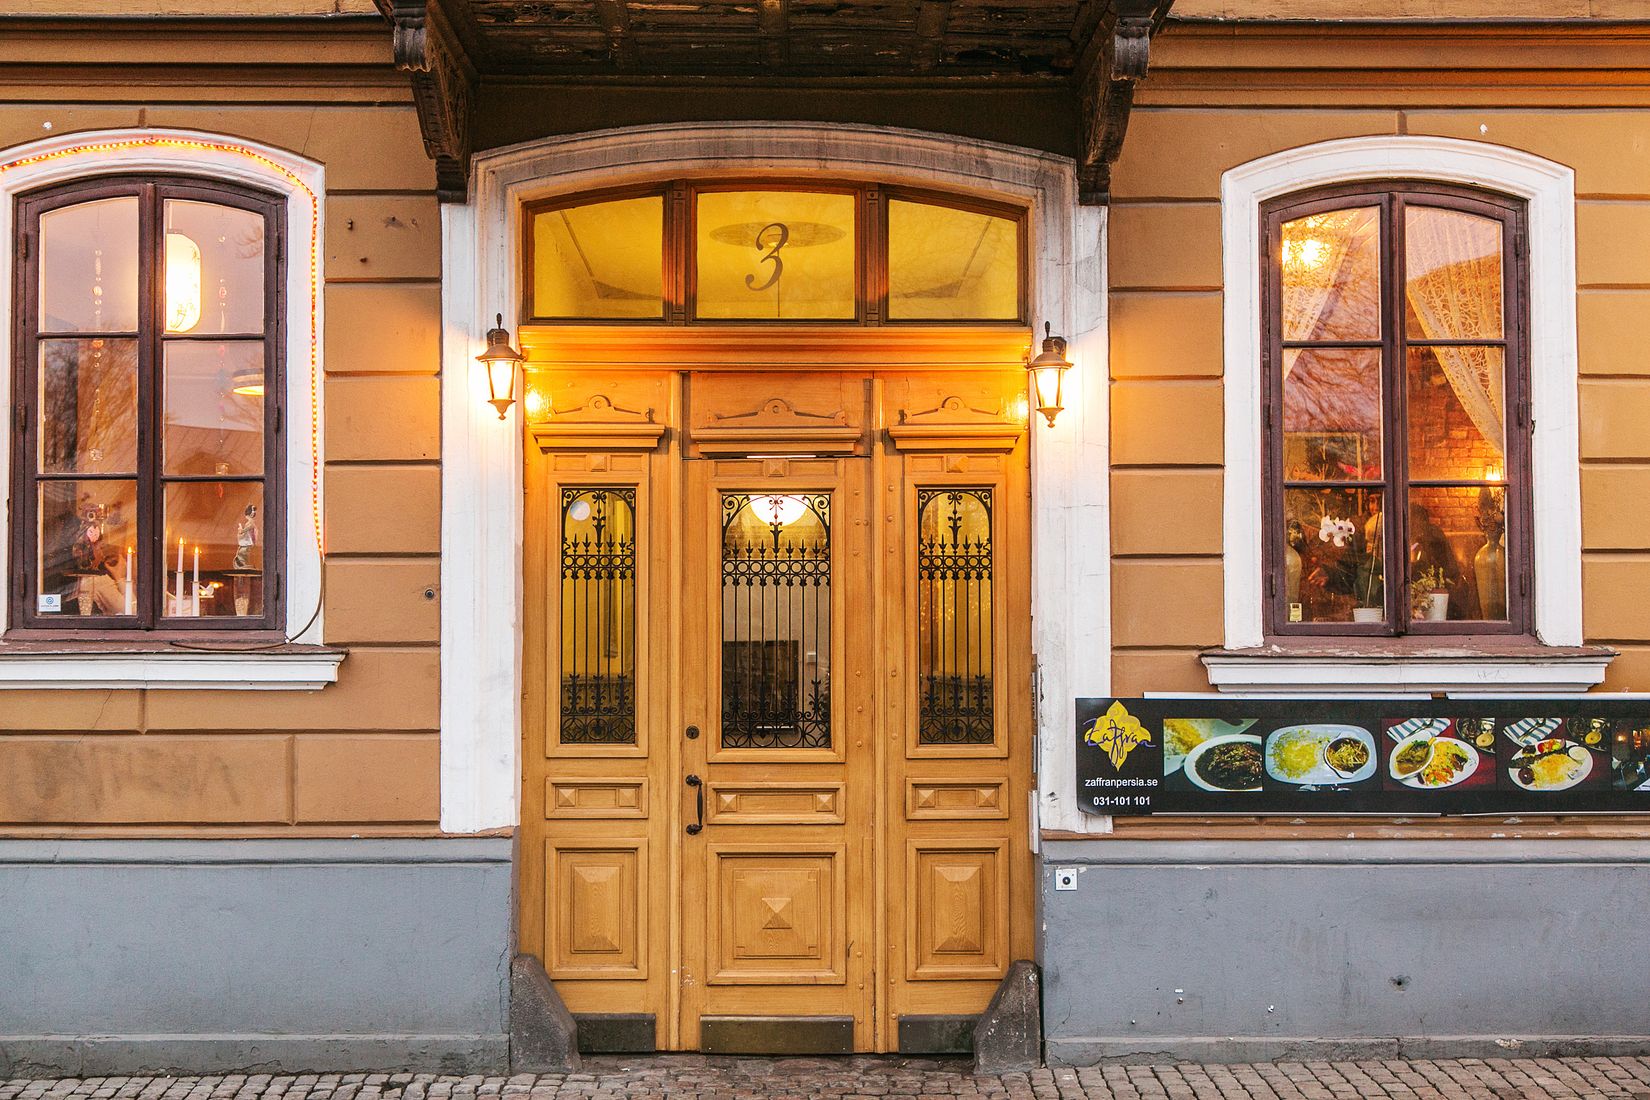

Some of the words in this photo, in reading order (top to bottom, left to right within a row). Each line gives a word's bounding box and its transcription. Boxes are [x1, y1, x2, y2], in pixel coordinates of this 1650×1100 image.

[745, 222, 789, 291] 3
[1082, 717, 1157, 767] Zaffran
[1084, 777, 1158, 788] zaffranpersia.se
[1093, 796, 1130, 806] 031-101
[1134, 796, 1150, 806] 101
